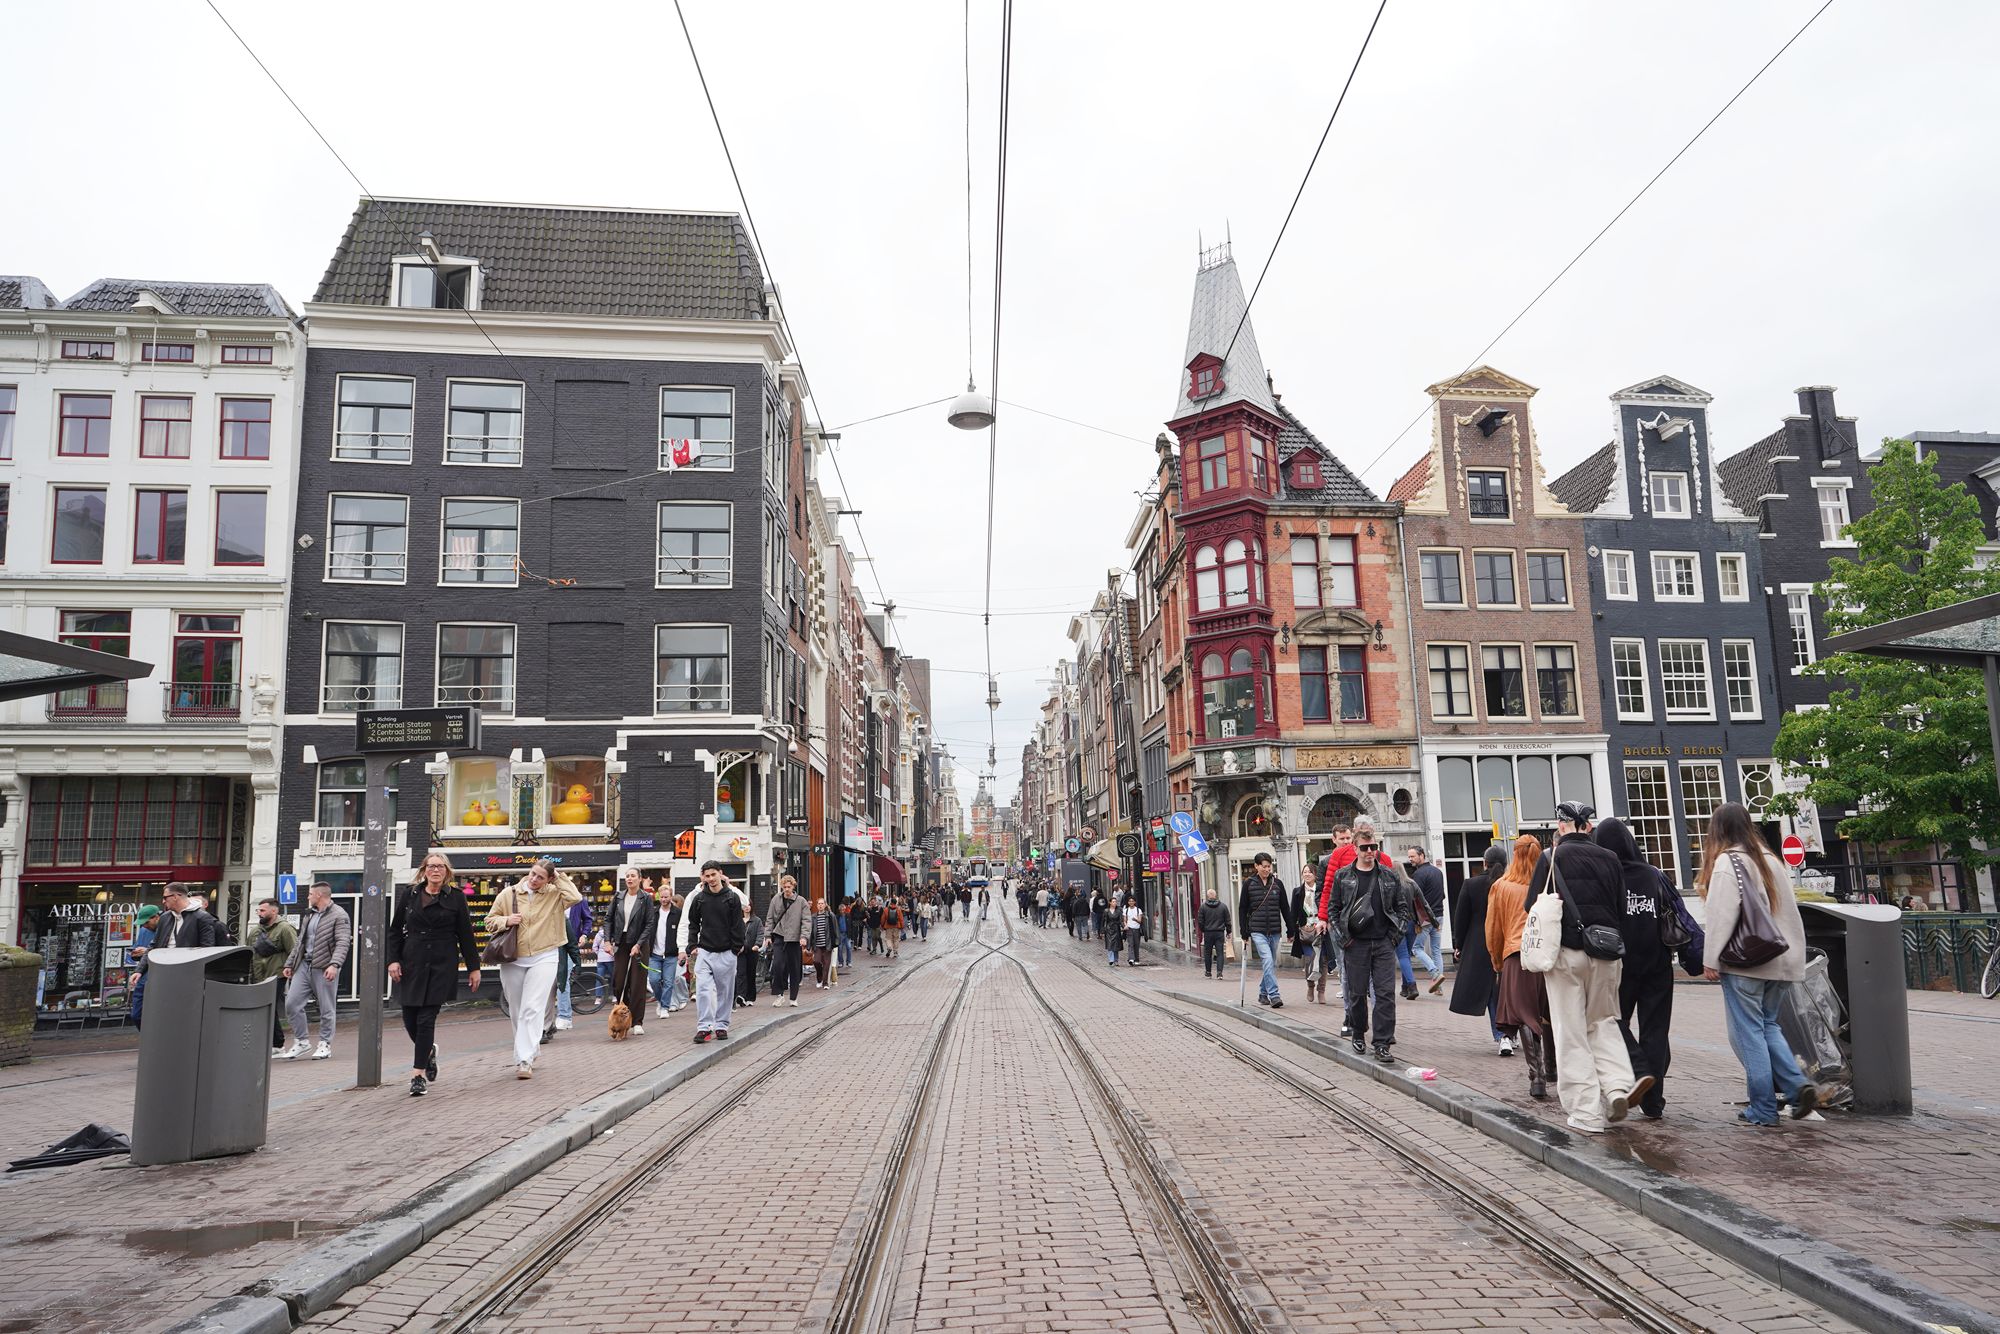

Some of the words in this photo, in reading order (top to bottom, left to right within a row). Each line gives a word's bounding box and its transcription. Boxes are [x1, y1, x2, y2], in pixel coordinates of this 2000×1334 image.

[1624, 746, 1671, 756] BAGELS
[1684, 746, 1723, 755] BEANS
[487, 855, 513, 864] Mama
[515, 855, 538, 864] Ducks
